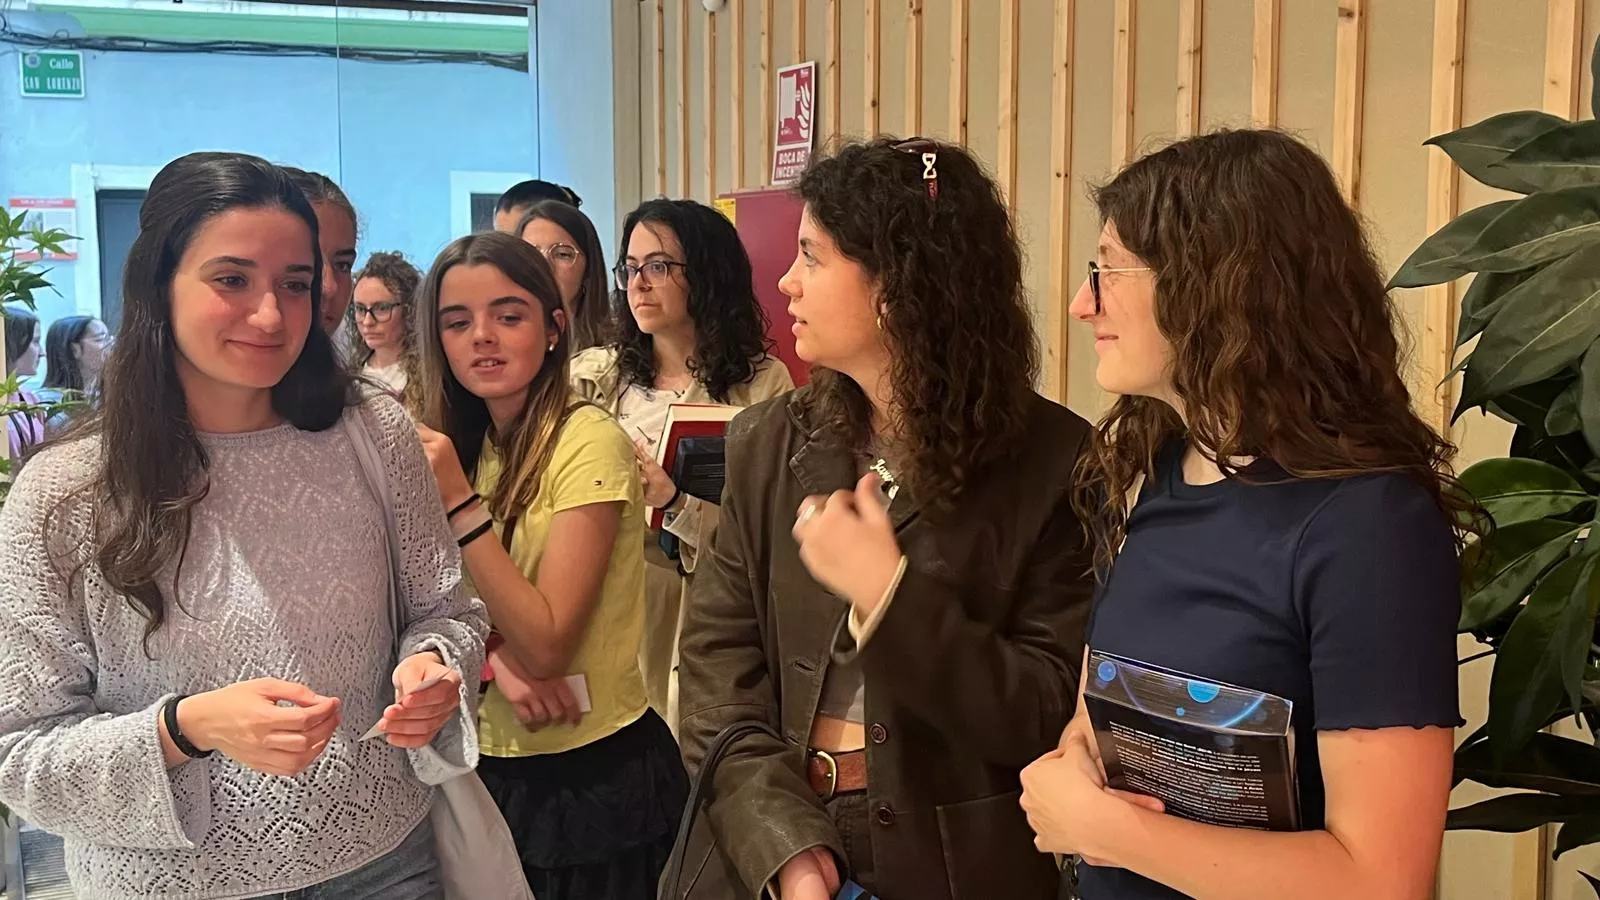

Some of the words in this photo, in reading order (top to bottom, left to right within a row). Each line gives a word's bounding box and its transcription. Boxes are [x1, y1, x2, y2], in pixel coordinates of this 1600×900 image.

[24, 76, 40, 89] SAN
[46, 76, 81, 90] LORENZO
[778, 151, 796, 165] BOCA
[796, 150, 806, 163] DE
